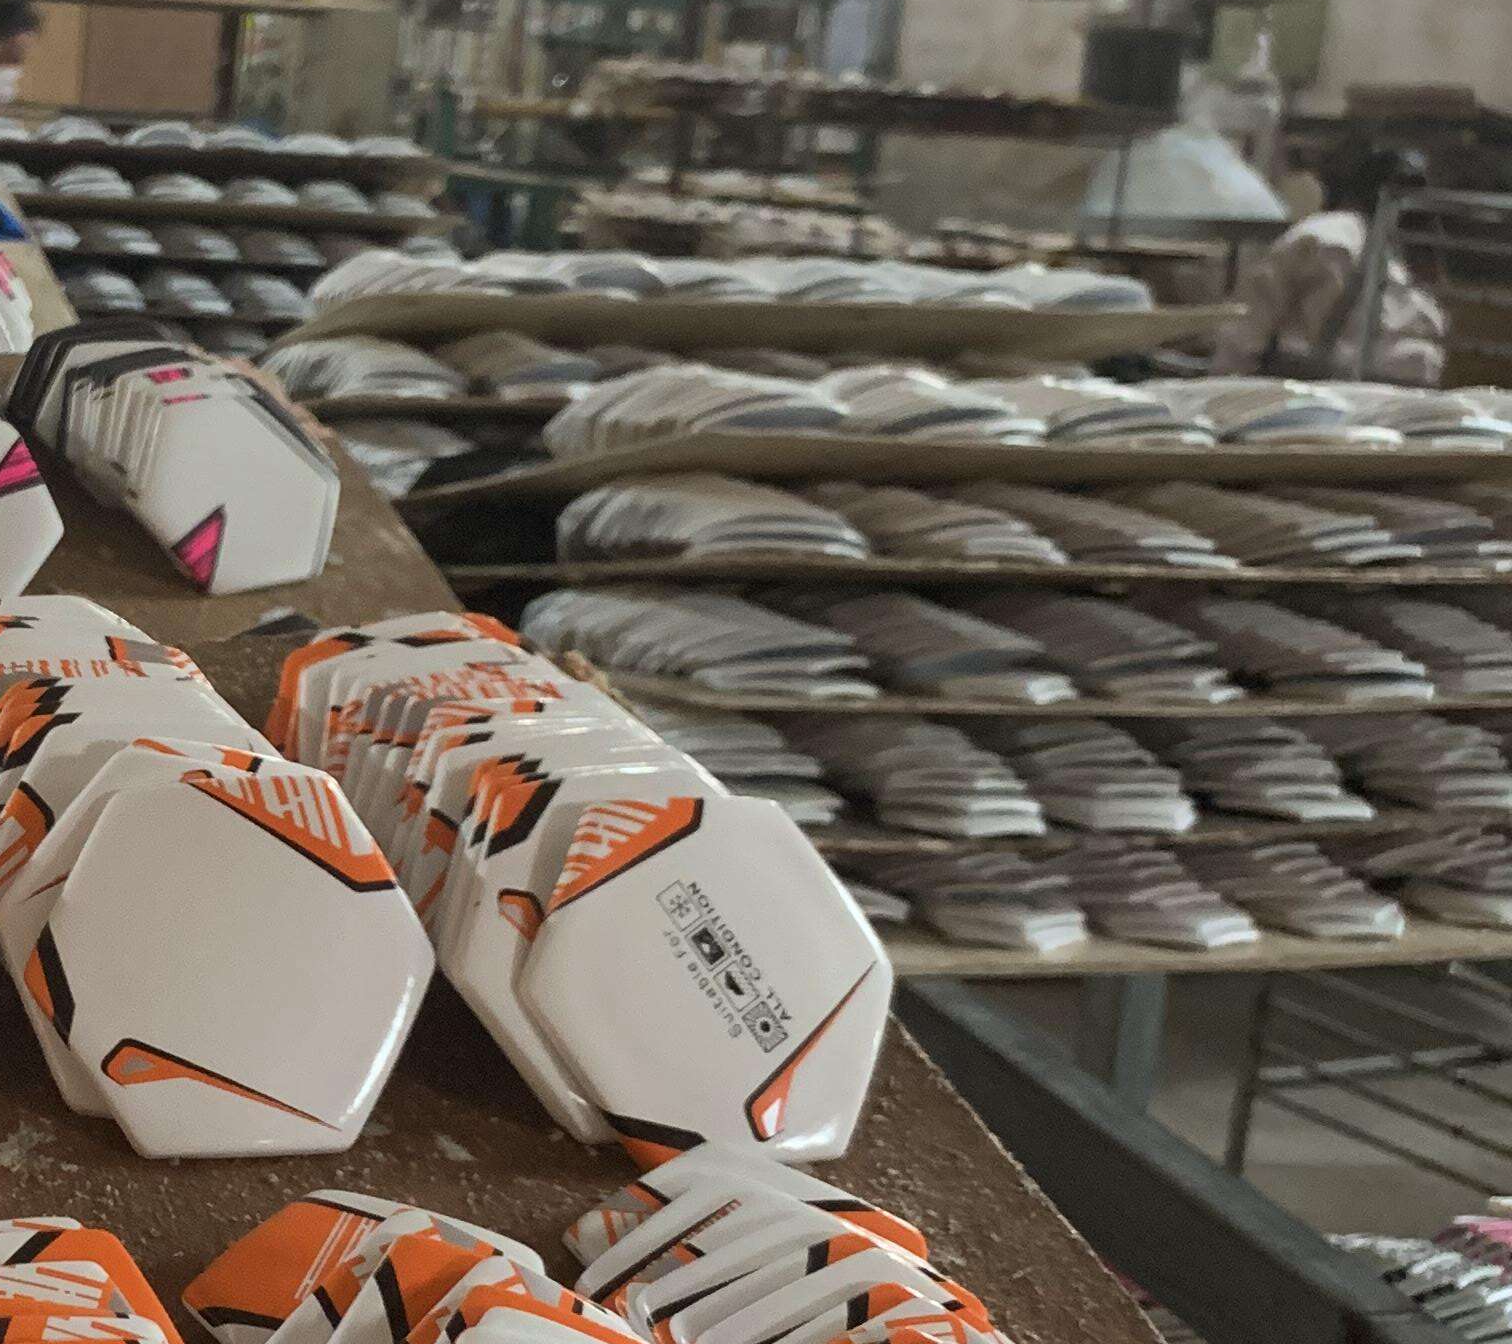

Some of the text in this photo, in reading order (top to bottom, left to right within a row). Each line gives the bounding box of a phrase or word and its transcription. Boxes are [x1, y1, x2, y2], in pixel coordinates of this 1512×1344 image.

[687, 882, 792, 1021] ALL CONDITION
[687, 962, 742, 1039] Suitable
